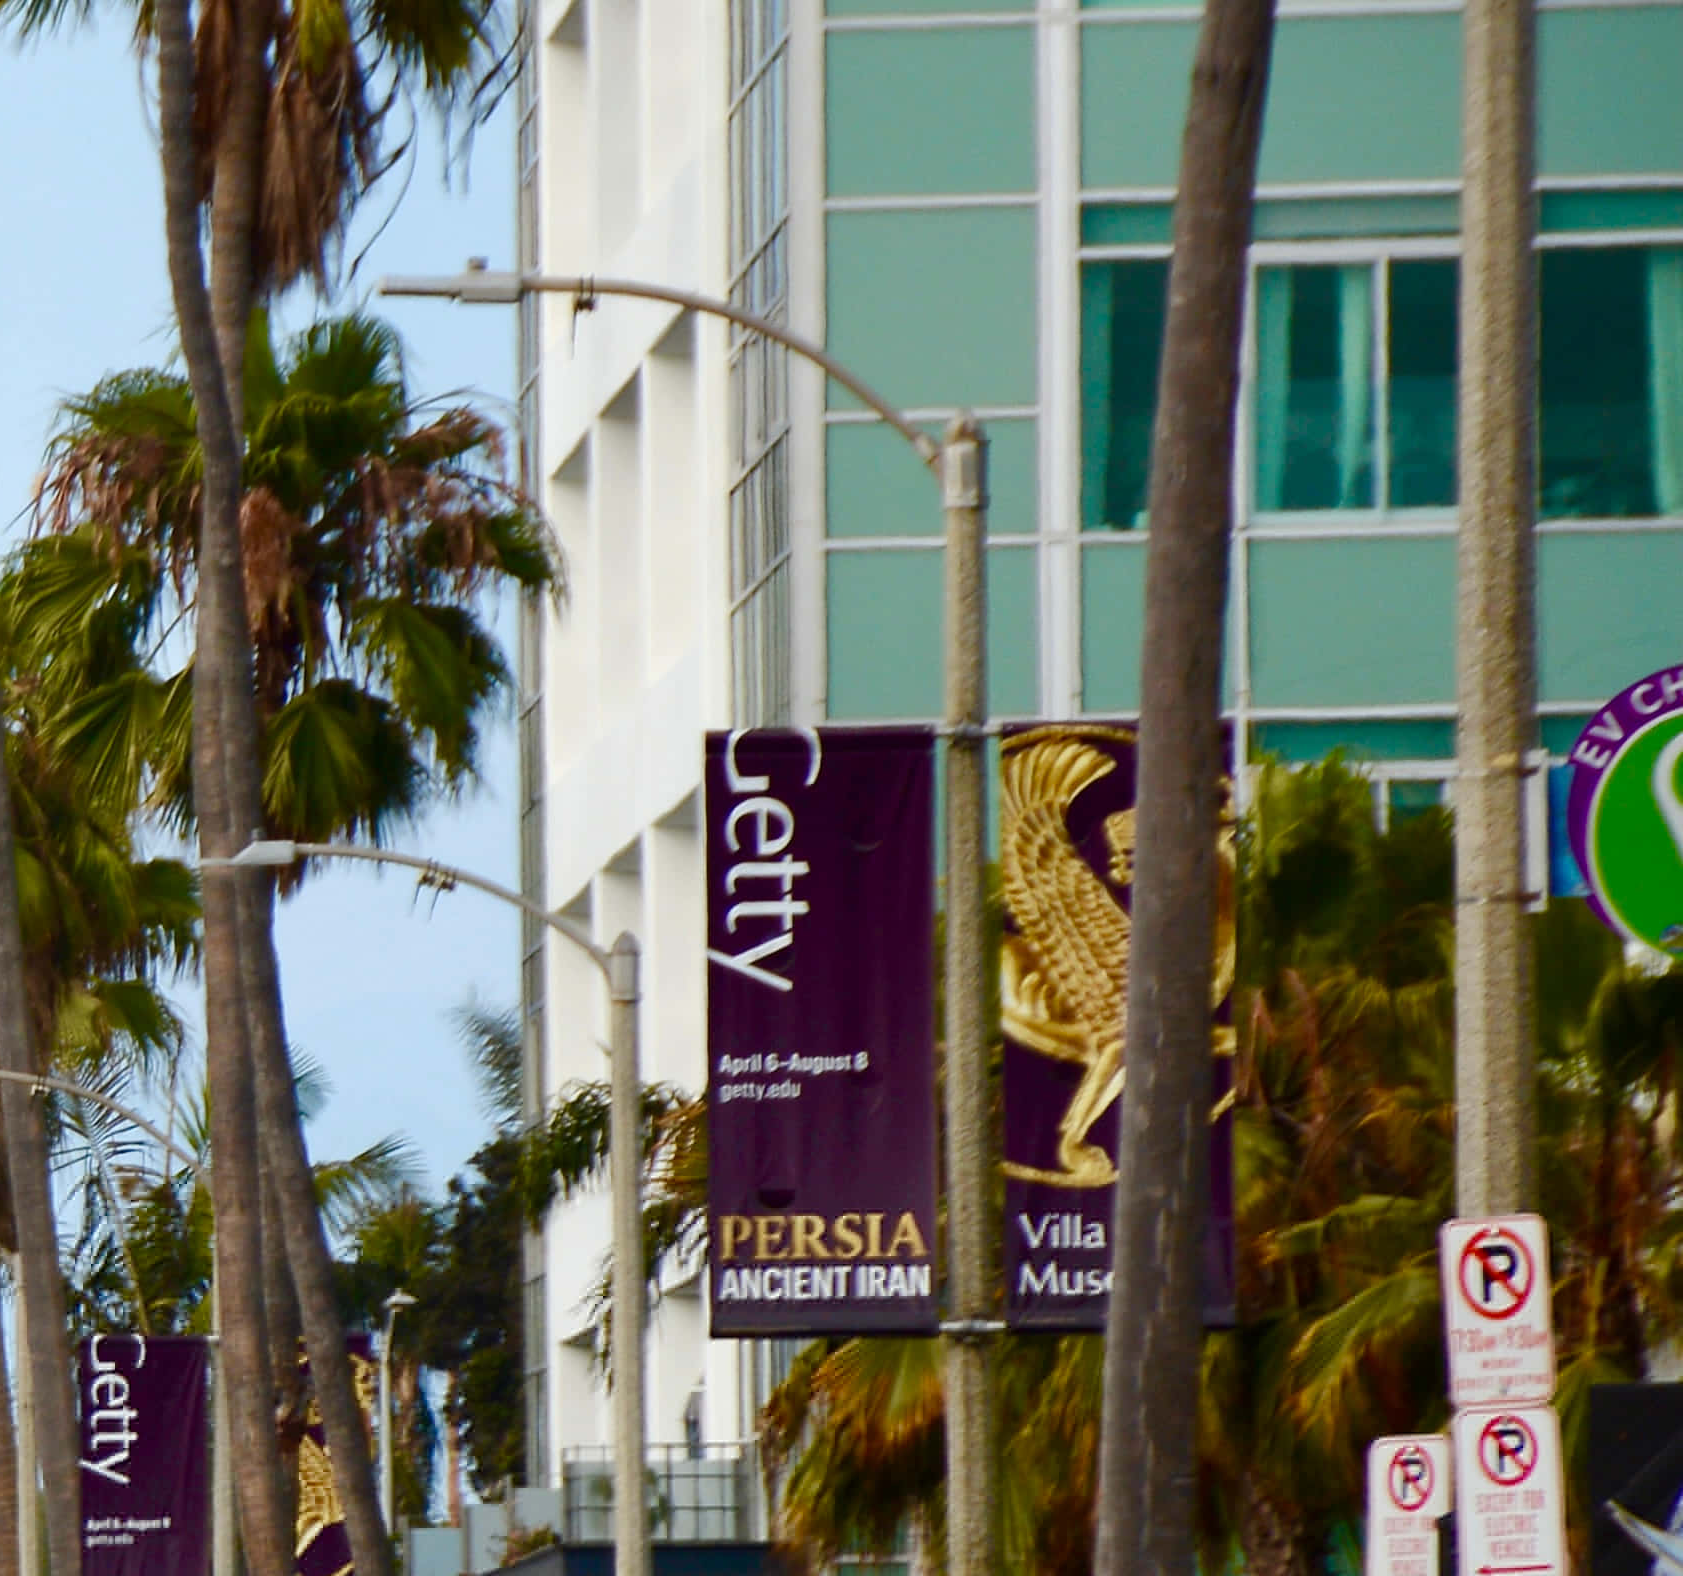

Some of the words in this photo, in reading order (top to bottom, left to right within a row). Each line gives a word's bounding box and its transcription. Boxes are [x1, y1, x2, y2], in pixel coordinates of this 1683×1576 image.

[1574, 710, 1625, 770] EV
[707, 727, 823, 991] Getty
[720, 1053, 762, 1075] April
[854, 1051, 869, 1072] 8
[720, 1079, 801, 1101] getty.edu
[720, 1211, 928, 1260] PERSIA
[1019, 1212, 1107, 1250] Villa
[720, 1265, 852, 1300] ANCIENT
[856, 1264, 931, 1298] IRAN
[78, 1334, 147, 1486] Getty
